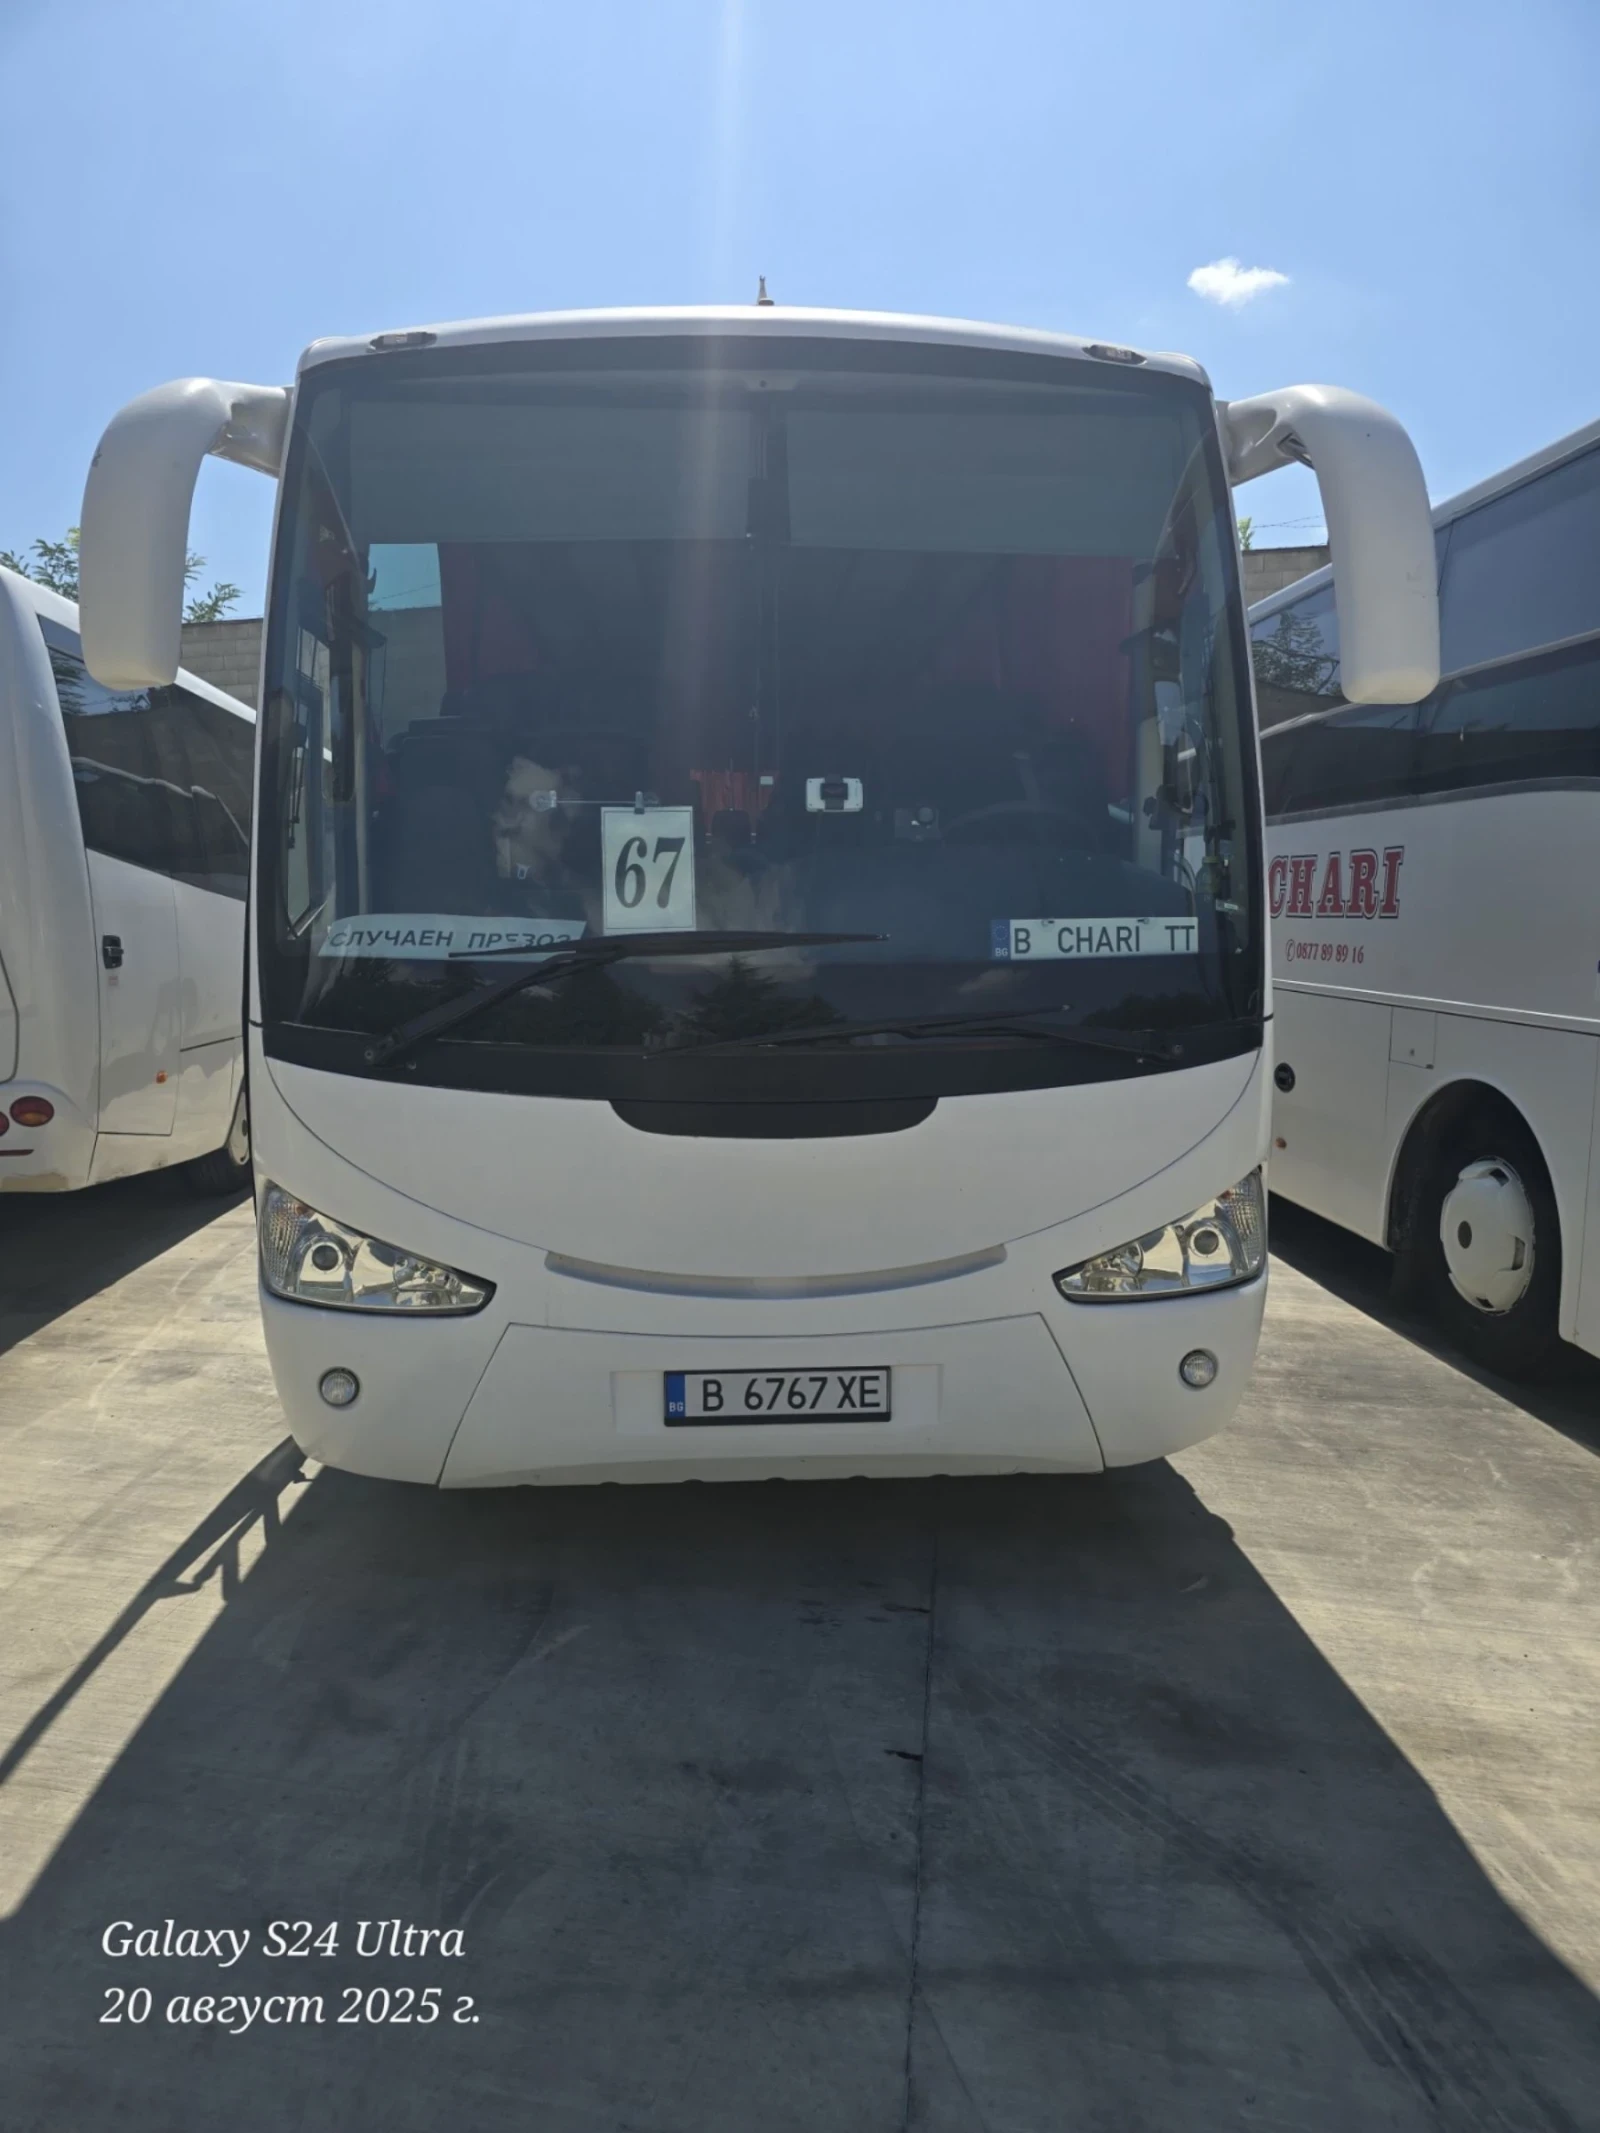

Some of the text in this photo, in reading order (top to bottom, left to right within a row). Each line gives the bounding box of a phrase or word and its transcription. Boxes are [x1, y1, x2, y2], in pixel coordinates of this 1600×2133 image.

[614, 836, 686, 909] 67
[1268, 845, 1405, 919] CHARI
[329, 929, 454, 947] СЛУЧАЕН
[1013, 925, 1196, 954] B CHARI TT
[994, 947, 1009, 957] BG
[1296, 942, 1365, 964] 0877 89 89 16
[702, 1375, 881, 1412] B 6767 XE
[668, 1402, 684, 1413] BG
